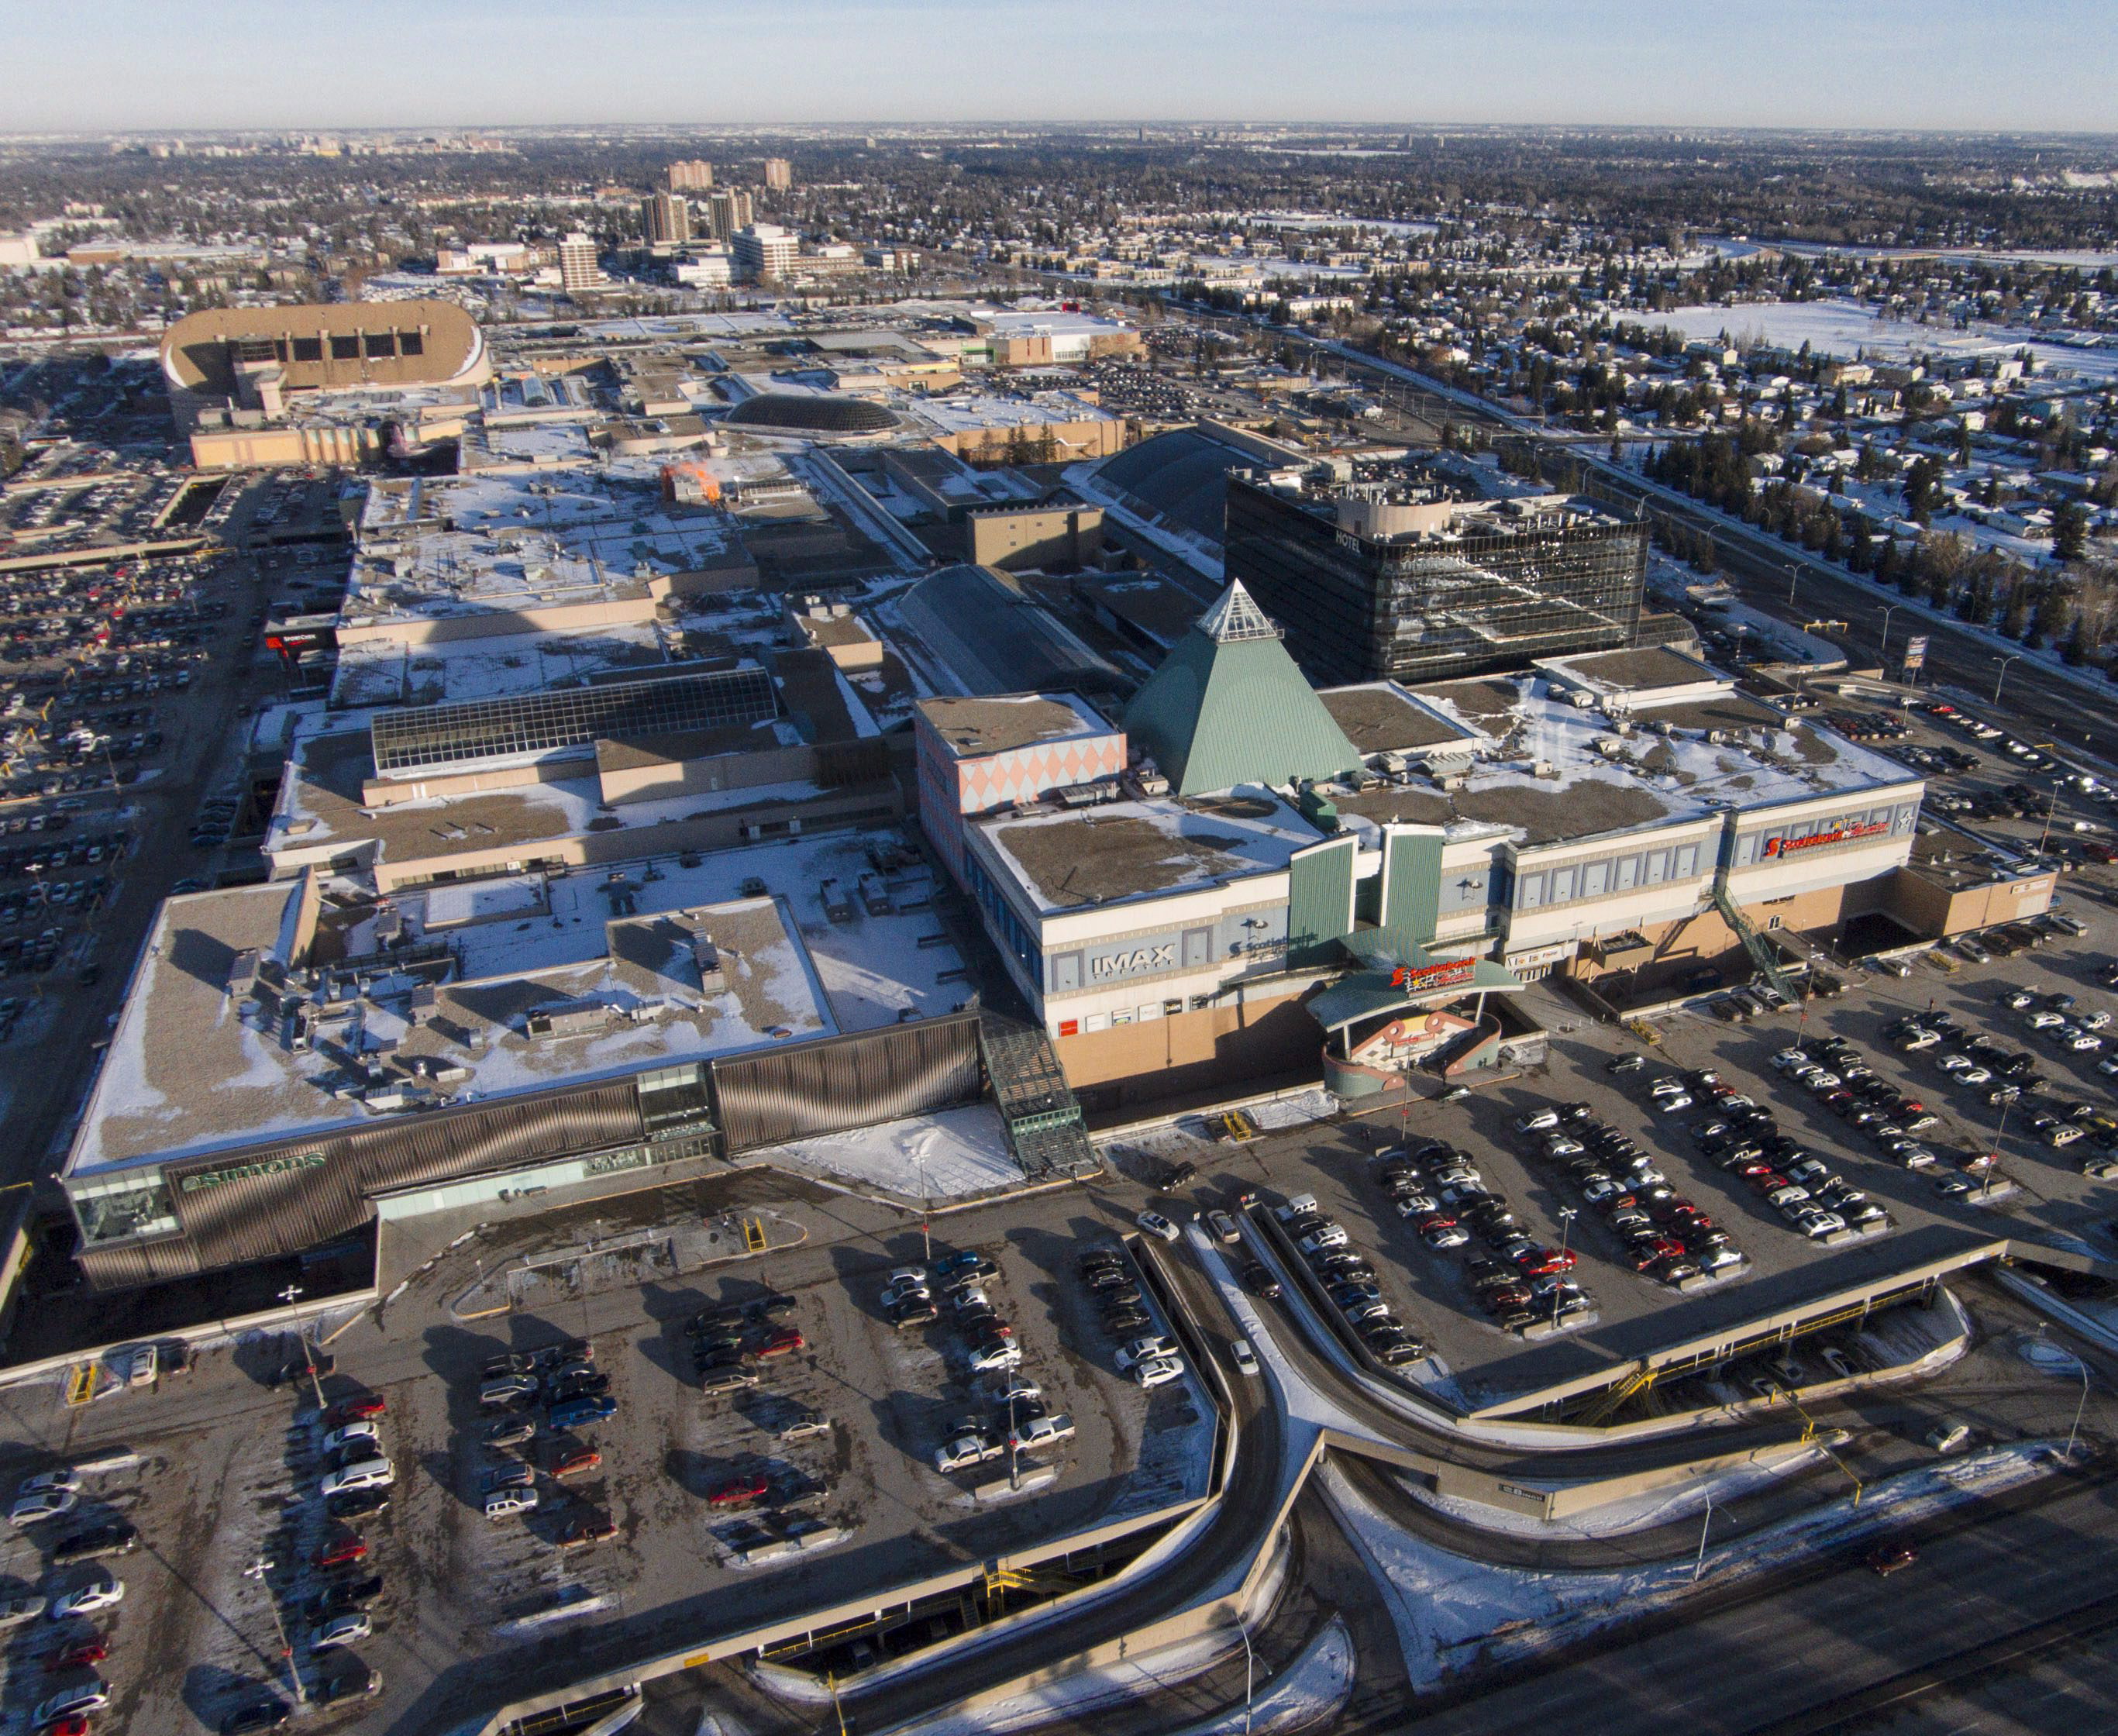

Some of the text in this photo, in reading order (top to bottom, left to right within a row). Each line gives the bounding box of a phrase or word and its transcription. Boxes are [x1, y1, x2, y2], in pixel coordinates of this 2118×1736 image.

[1335, 529, 1361, 553] HOTEL
[1782, 830, 1844, 851] Scotiabank
[1092, 943, 1176, 973] IMAX
[1410, 956, 1476, 977] Scotiabank
